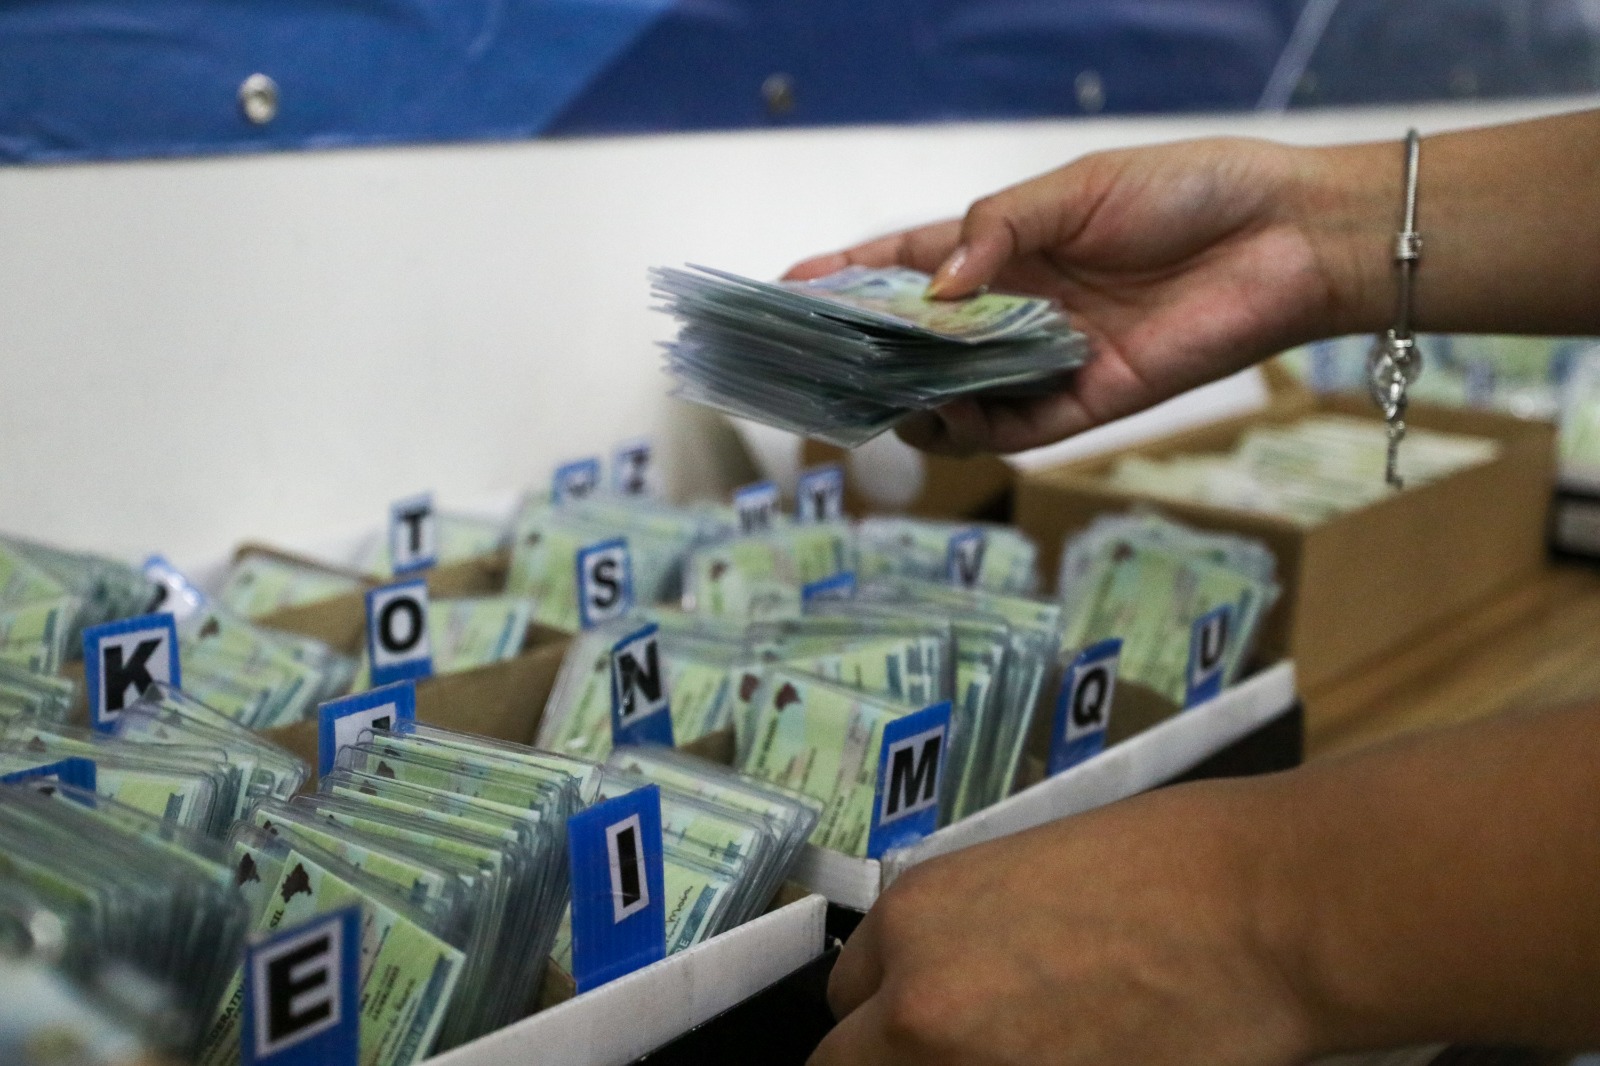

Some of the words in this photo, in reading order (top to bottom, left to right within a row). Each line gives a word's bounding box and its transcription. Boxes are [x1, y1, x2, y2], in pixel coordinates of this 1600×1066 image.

[400, 507, 430, 554] T
[592, 557, 621, 609] S
[955, 542, 986, 588] V
[379, 595, 423, 653] O
[1201, 611, 1229, 670] U
[104, 637, 162, 713] K
[618, 639, 662, 717] N
[1073, 667, 1108, 727] Q
[886, 735, 941, 816] M
[616, 825, 641, 908] I
[267, 937, 330, 1042] E
